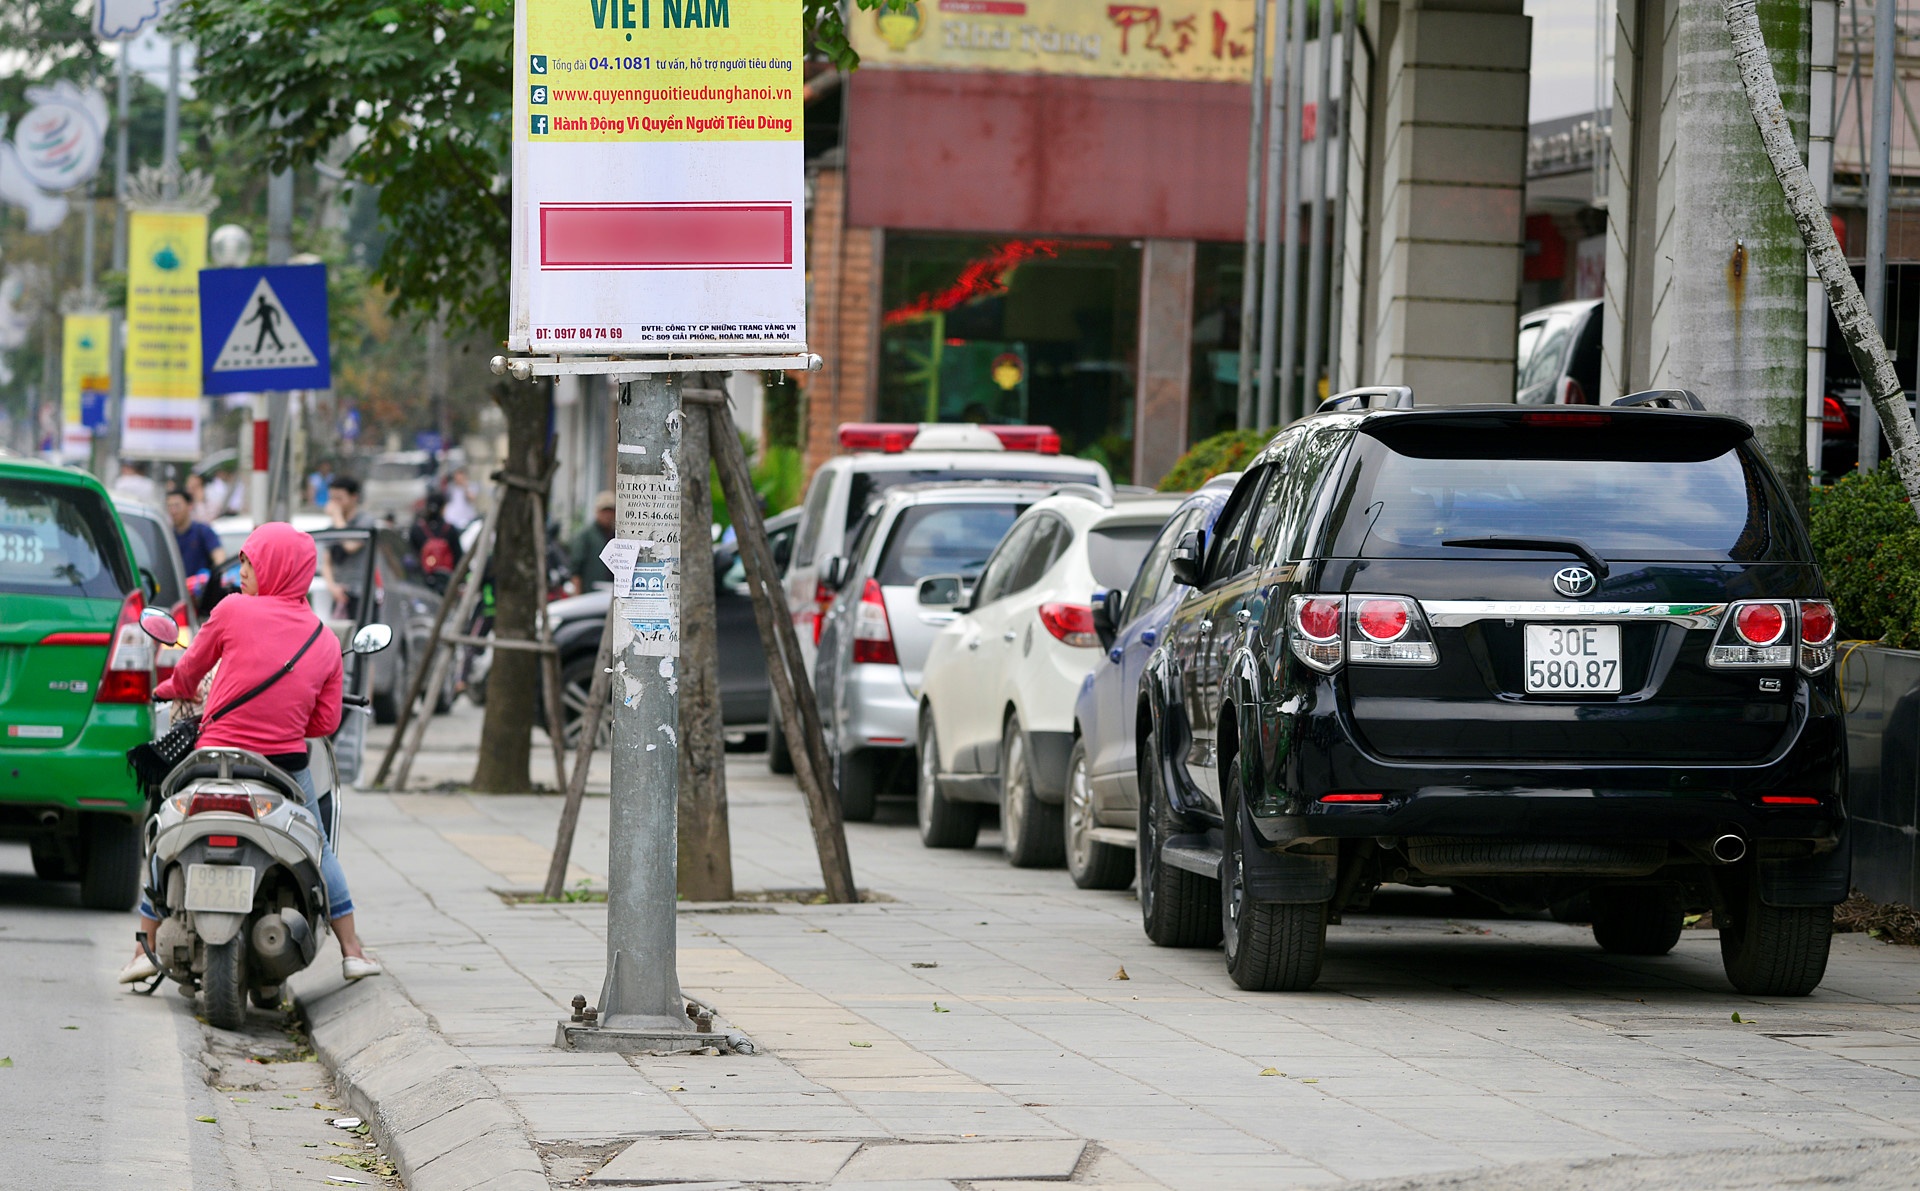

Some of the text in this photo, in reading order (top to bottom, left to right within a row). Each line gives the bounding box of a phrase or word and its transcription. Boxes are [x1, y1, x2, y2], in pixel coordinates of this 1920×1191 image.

[663, 0, 730, 29] NAM
[552, 56, 792, 72] Tổng đài 04.1081 tư vấn, hỗ trợ người tiêu dùng
[552, 85, 792, 104] www.quyennguoitieudunghanoi.vn
[553, 114, 793, 134] Hành Động Vì Quyền Người Tiêu Dùng
[536, 327, 623, 339] ĐT: 0917 84 74 69
[665, 323, 686, 332] CÔNG
[711, 323, 737, 331] NHỮNG
[776, 332, 790, 340] NỘI
[1549, 628, 1598, 656] 30E
[1529, 660, 1617, 689] 580.87
